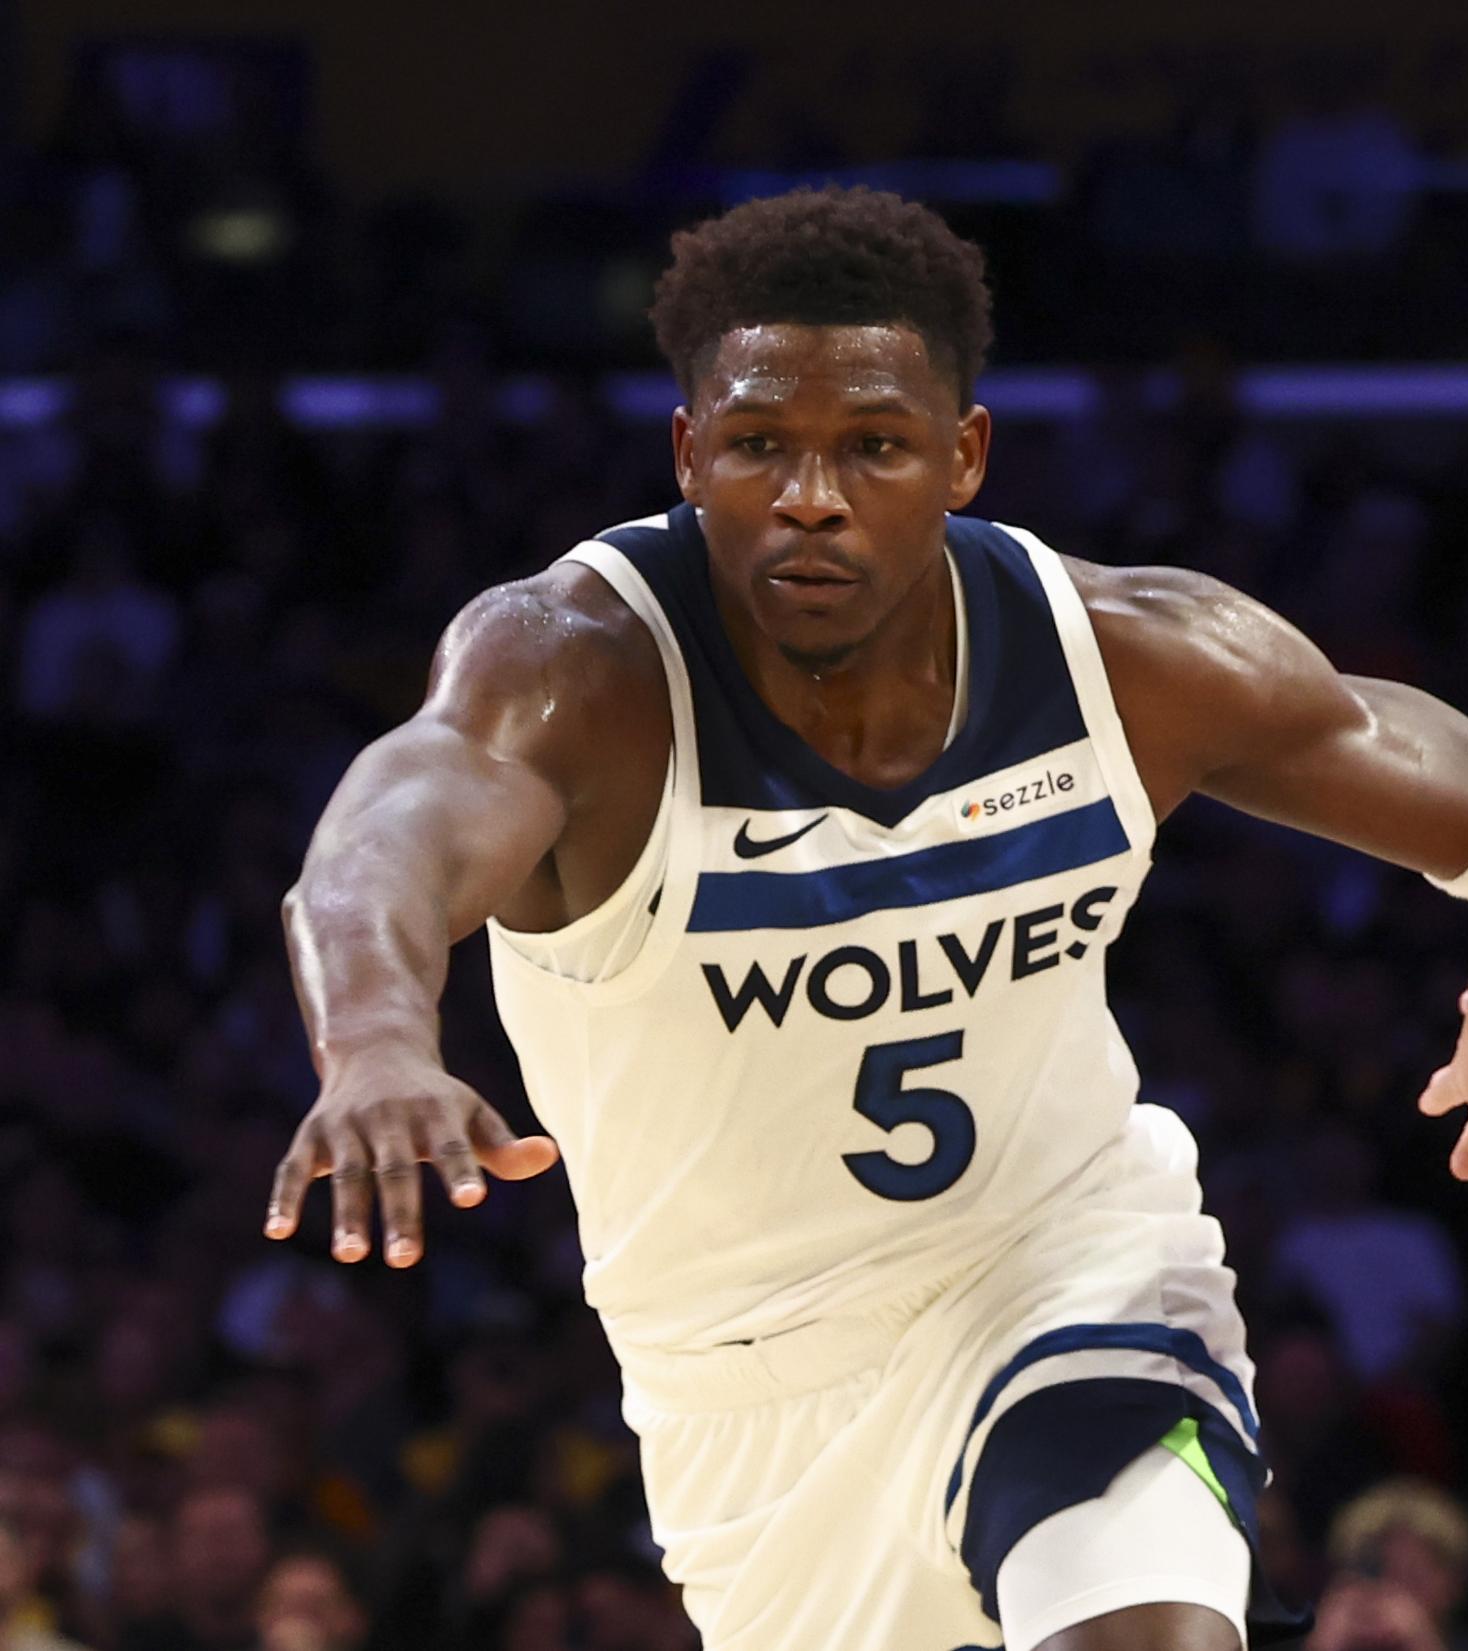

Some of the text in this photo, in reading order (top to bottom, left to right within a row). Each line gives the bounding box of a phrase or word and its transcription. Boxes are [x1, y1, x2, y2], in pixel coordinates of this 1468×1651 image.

[983, 770, 1075, 816] sezzle
[701, 886, 1118, 1034] WOLVES
[841, 1029, 977, 1201] 5
